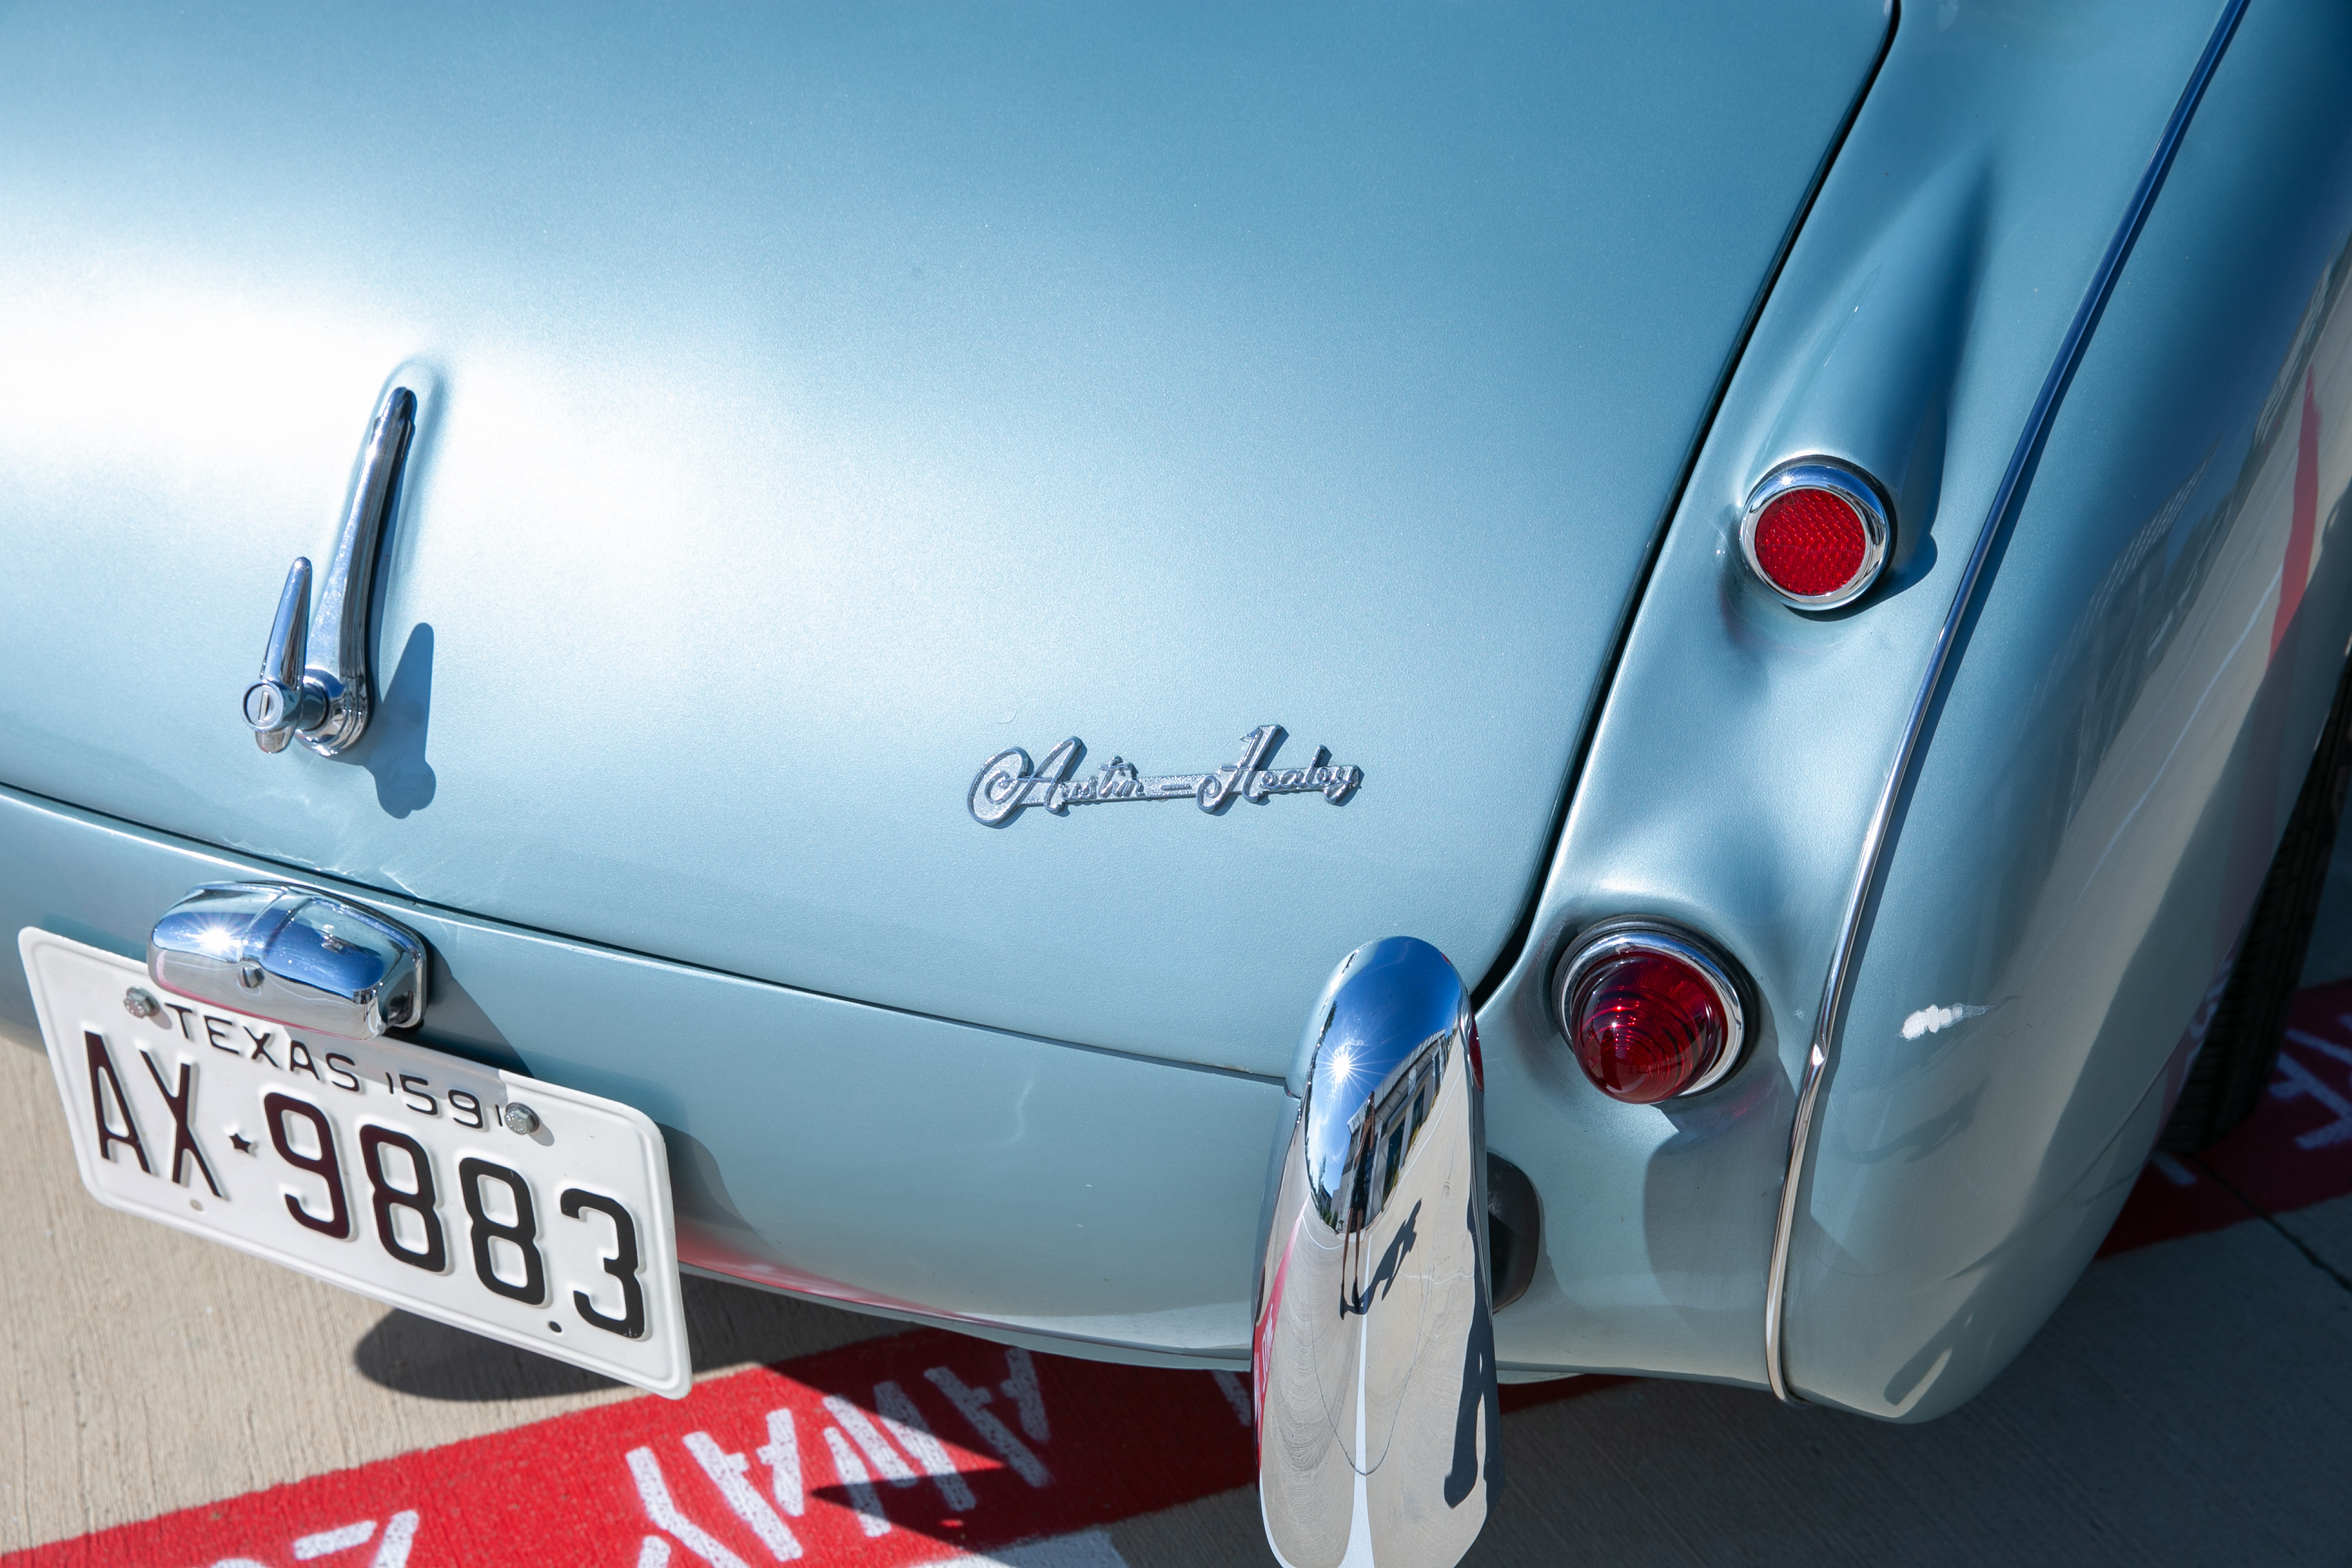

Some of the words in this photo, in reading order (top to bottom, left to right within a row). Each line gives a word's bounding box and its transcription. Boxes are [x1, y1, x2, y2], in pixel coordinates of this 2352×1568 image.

[165, 1002, 361, 1093] TEXAS
[264, 1092, 646, 1338] 9883
[625, 1346, 1050, 1568] AWAY
